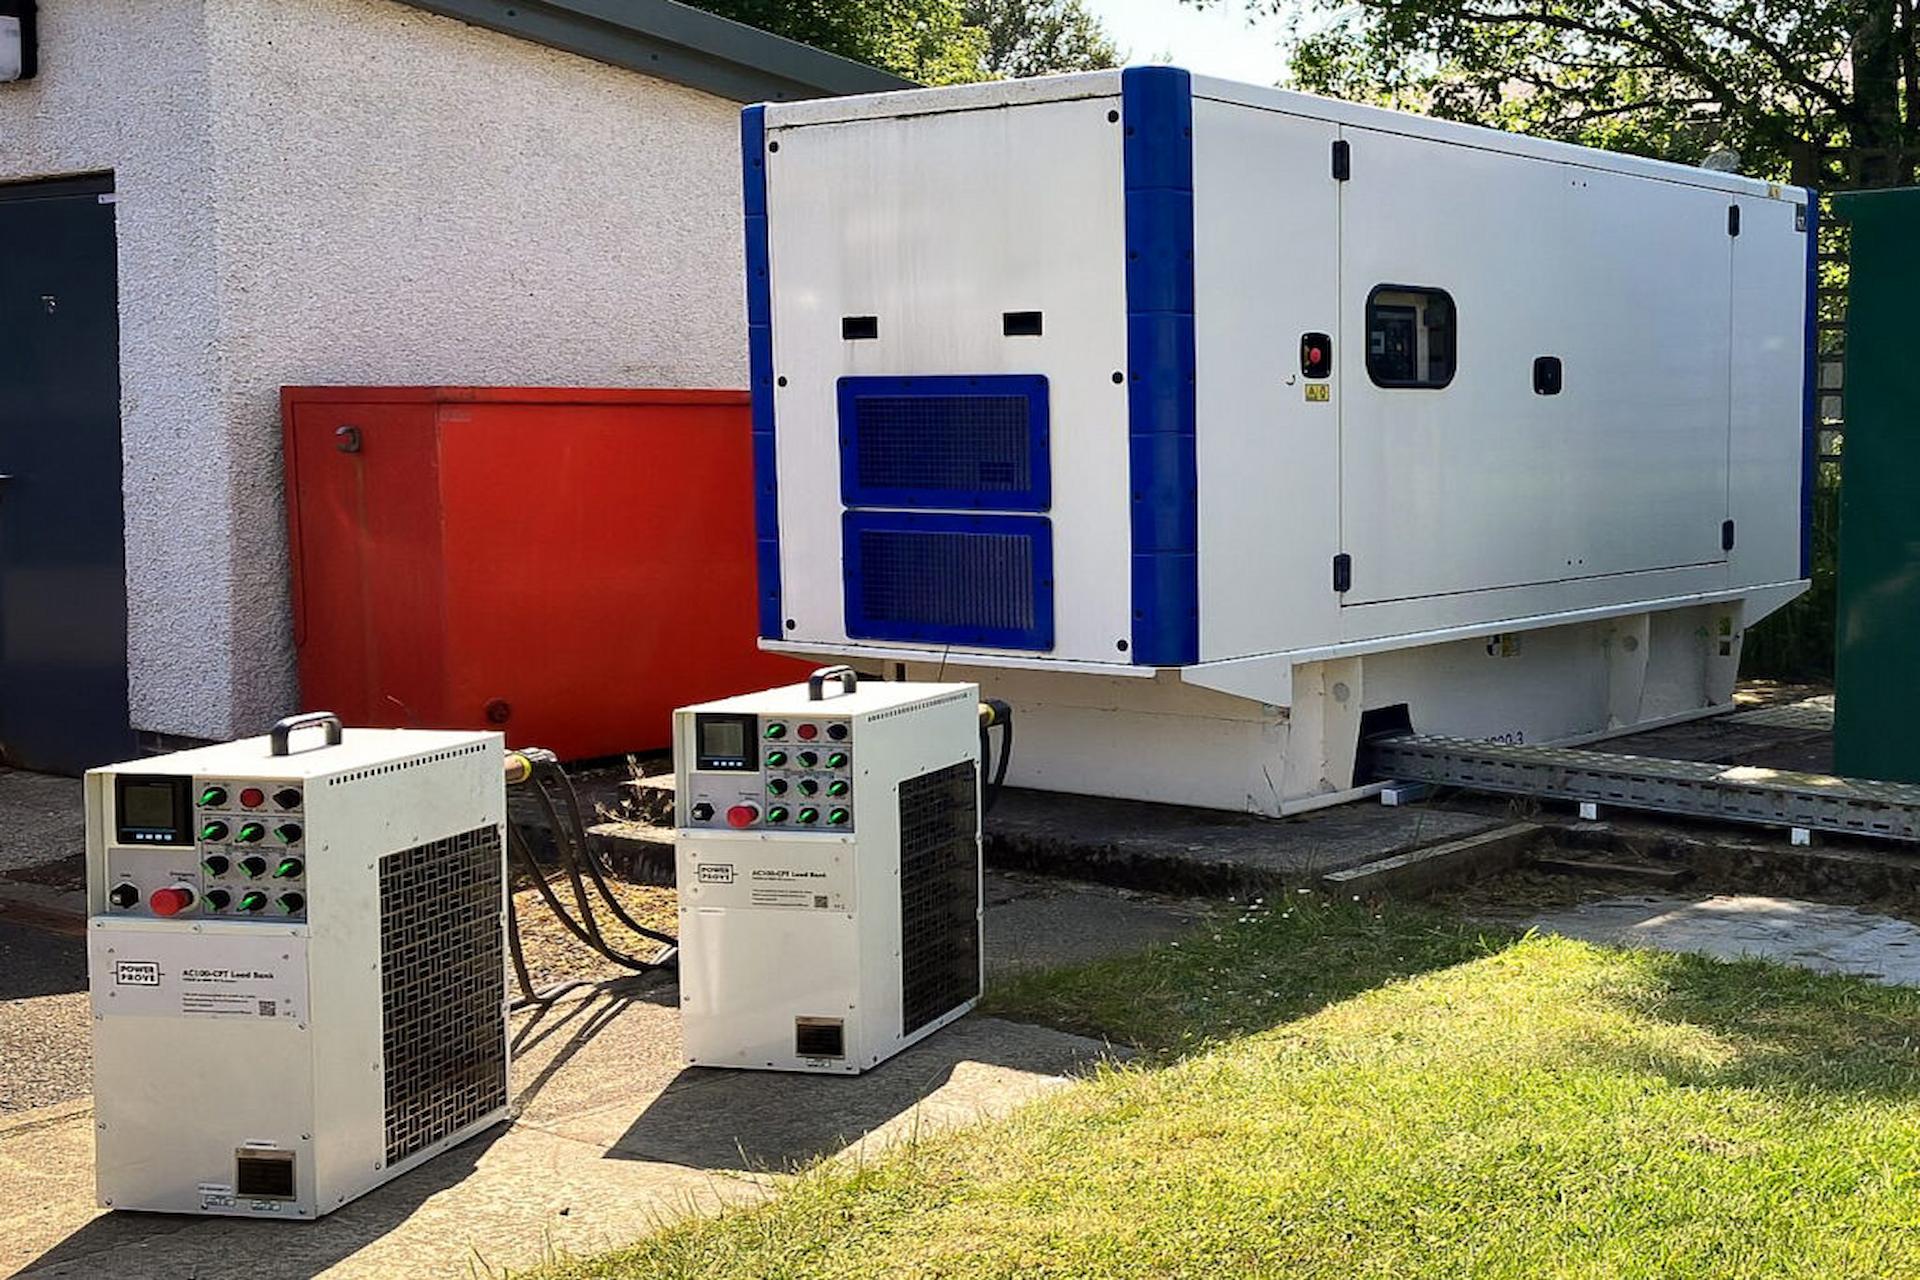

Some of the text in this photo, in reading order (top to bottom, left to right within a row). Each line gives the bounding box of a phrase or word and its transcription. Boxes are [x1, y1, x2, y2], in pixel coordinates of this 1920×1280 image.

[120, 965, 155, 974] POWER
[121, 974, 156, 983] PROVE
[231, 971, 251, 979] Load
[253, 972, 275, 980] Bank
